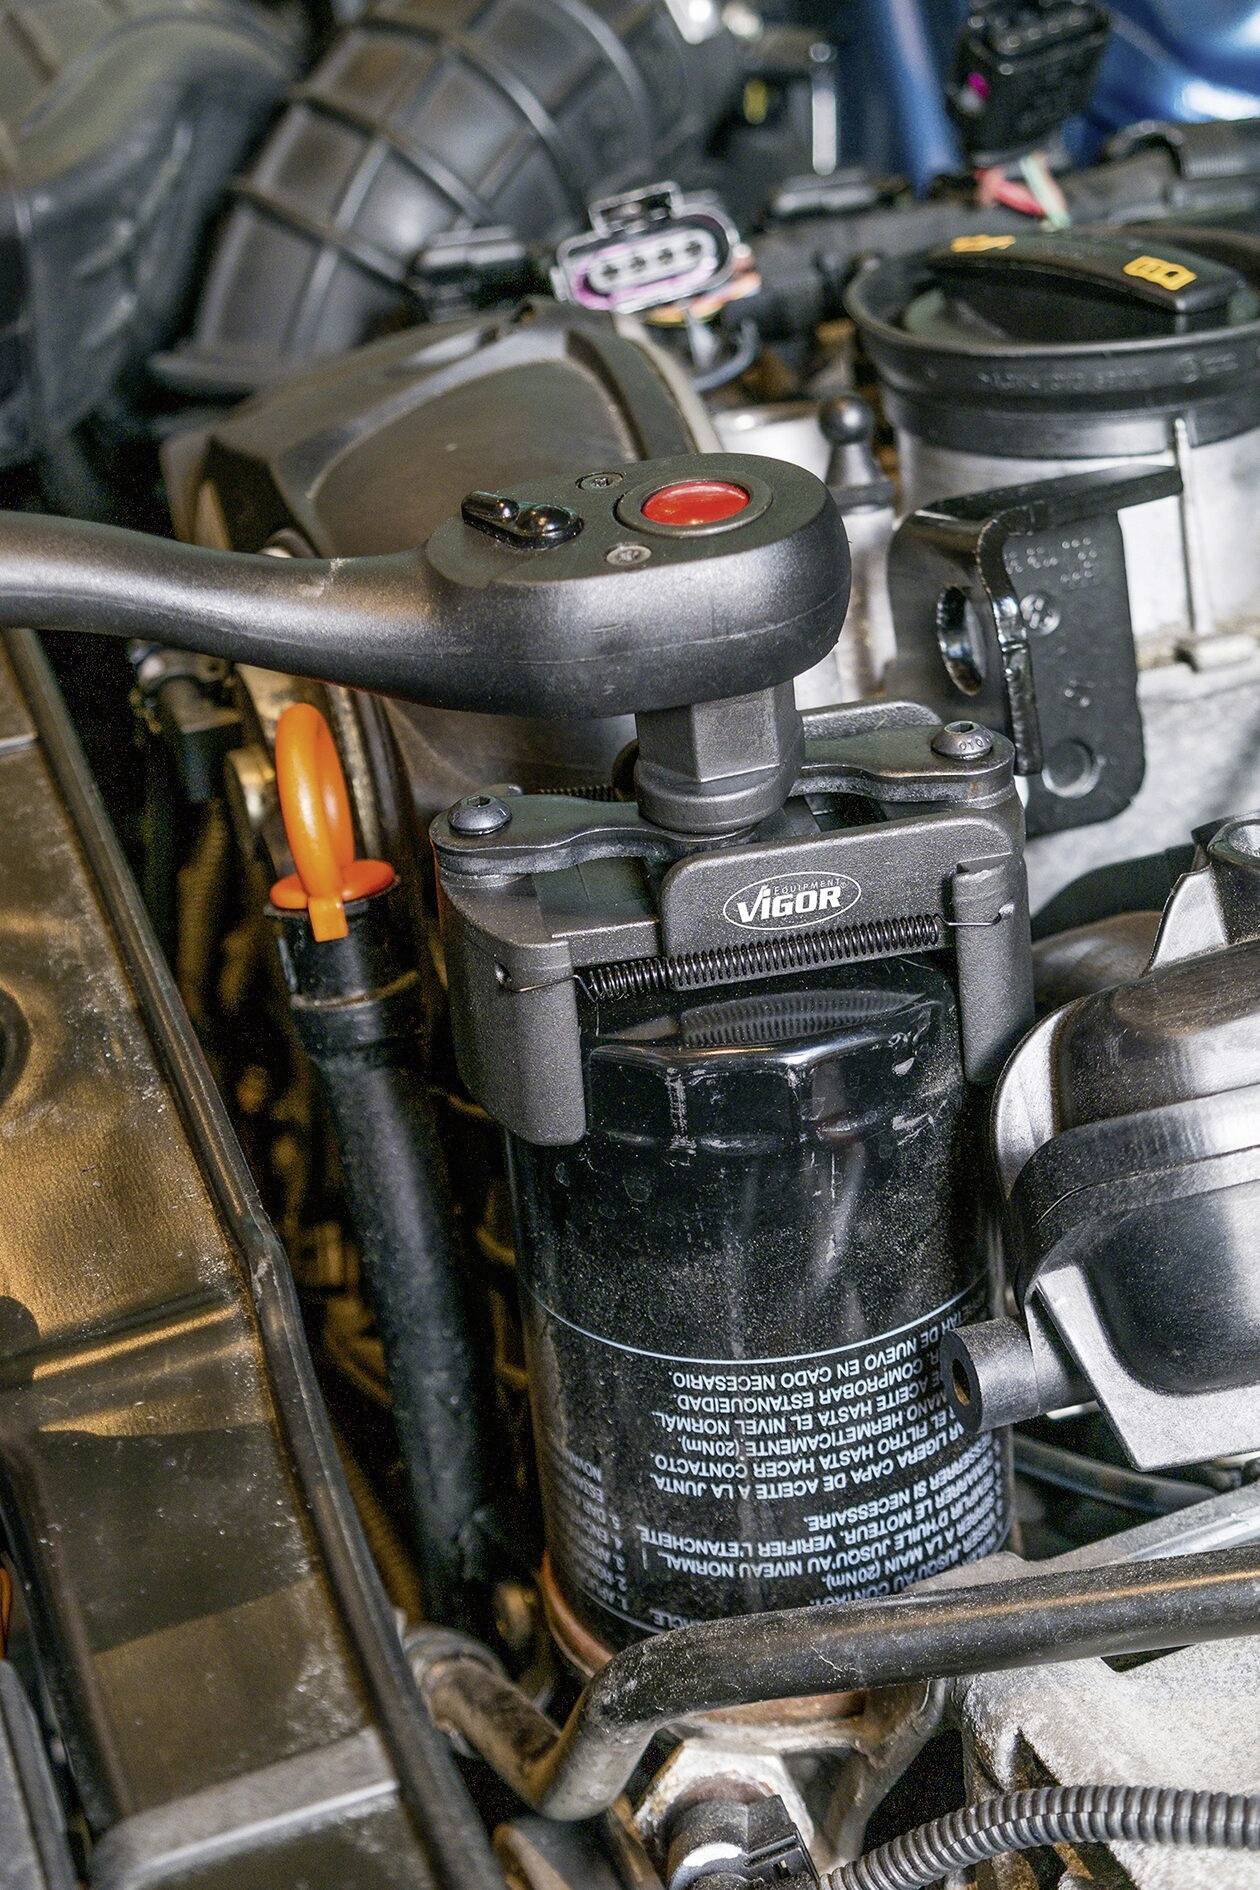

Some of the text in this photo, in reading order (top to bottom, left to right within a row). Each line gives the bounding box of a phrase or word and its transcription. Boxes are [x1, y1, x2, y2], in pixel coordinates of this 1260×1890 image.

[774, 878, 840, 895] EQUIPMENT
[920, 1326, 939, 1348] DE
[864, 1338, 917, 1370] NUEVO
[781, 1366, 832, 1389] CADO
[837, 1359, 860, 1379] EN
[668, 1371, 776, 1391] NECESARIO.
[673, 1360, 923, 1413] COMPROBAR ESTANQUEIDAD.
[876, 1376, 928, 1412] ACEITE
[790, 1413, 813, 1430] EL
[817, 1399, 872, 1427] HASTA
[930, 1409, 947, 1429] EL
[734, 1418, 786, 1435] NIVEL
[745, 1410, 903, 1456] HERMETICAMENTE
[677, 1435, 740, 1456] (20Nm).
[877, 1422, 928, 1455] FILTRO
[896, 1431, 947, 1469] LIGERA
[650, 1453, 748, 1478] CONTACTO.
[752, 1458, 815, 1478] HACER
[818, 1443, 873, 1470] HASTA
[823, 1472, 846, 1492] DE
[850, 1459, 894, 1484] CAPA
[649, 1473, 707, 1497] JUNTA.
[710, 1483, 734, 1499] LA
[738, 1484, 751, 1499] A
[755, 1478, 819, 1500] ACEITE
[913, 1479, 927, 1500] SI
[803, 1488, 910, 1531] NECESSAIRE.
[914, 1498, 933, 1521] LE
[840, 1508, 912, 1545] MOTEUR.
[893, 1509, 949, 1551] D'HUILE
[944, 1527, 955, 1544] A
[758, 1533, 836, 1557] VERIFIER
[807, 1537, 891, 1574] JUSQU'AU
[924, 1535, 943, 1556] LA
[739, 1560, 802, 1578] NIVEAU
[885, 1545, 923, 1575] MAIN
[821, 1560, 880, 1591] (20Nm).
